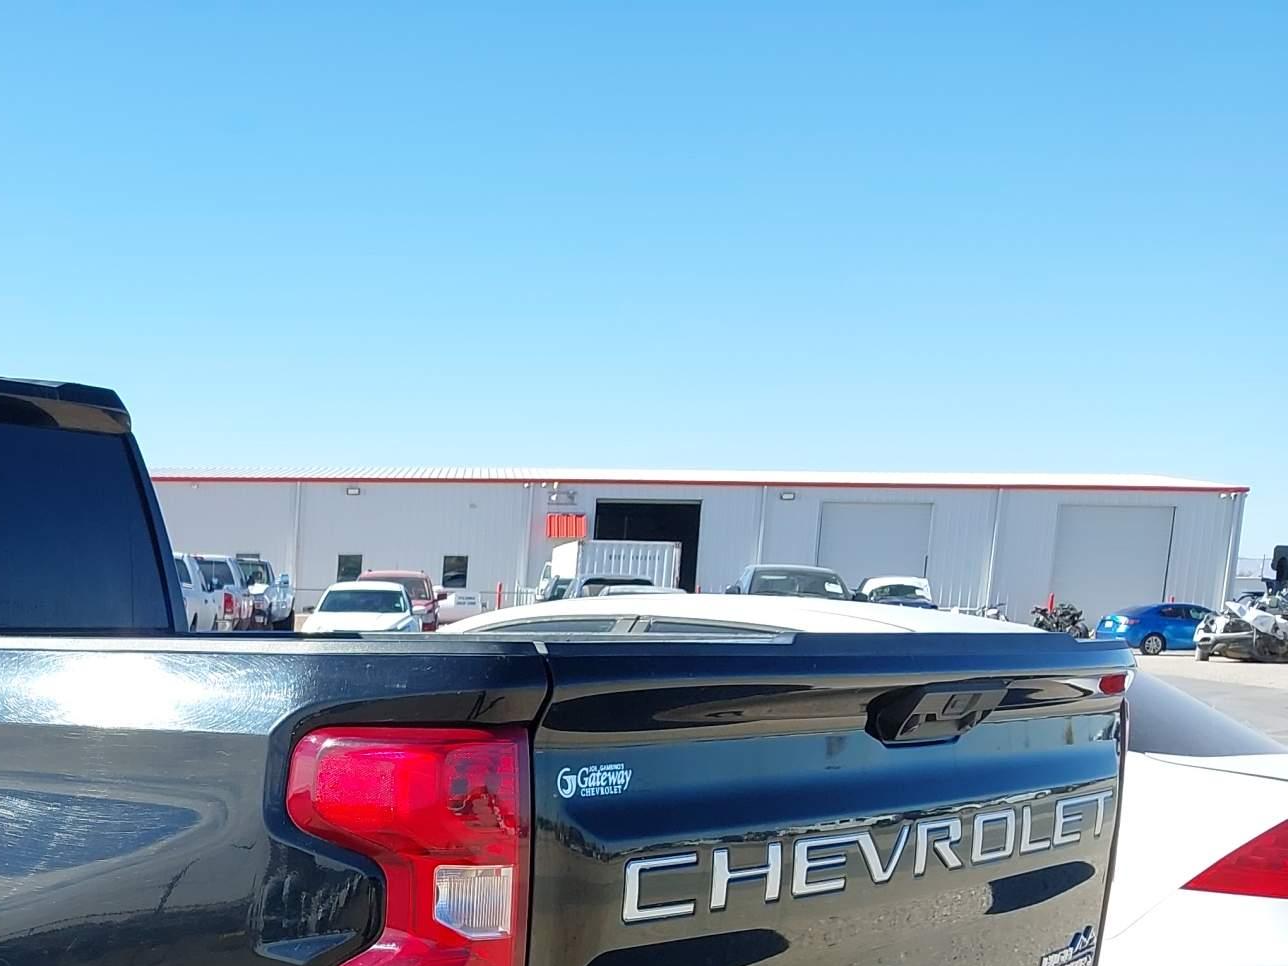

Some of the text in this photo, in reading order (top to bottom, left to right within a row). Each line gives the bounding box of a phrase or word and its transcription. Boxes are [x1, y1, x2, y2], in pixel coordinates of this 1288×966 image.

[577, 766, 632, 791] Gateway
[580, 785, 622, 797] CHEVROLET
[622, 788, 1113, 924] CHEVROLET
